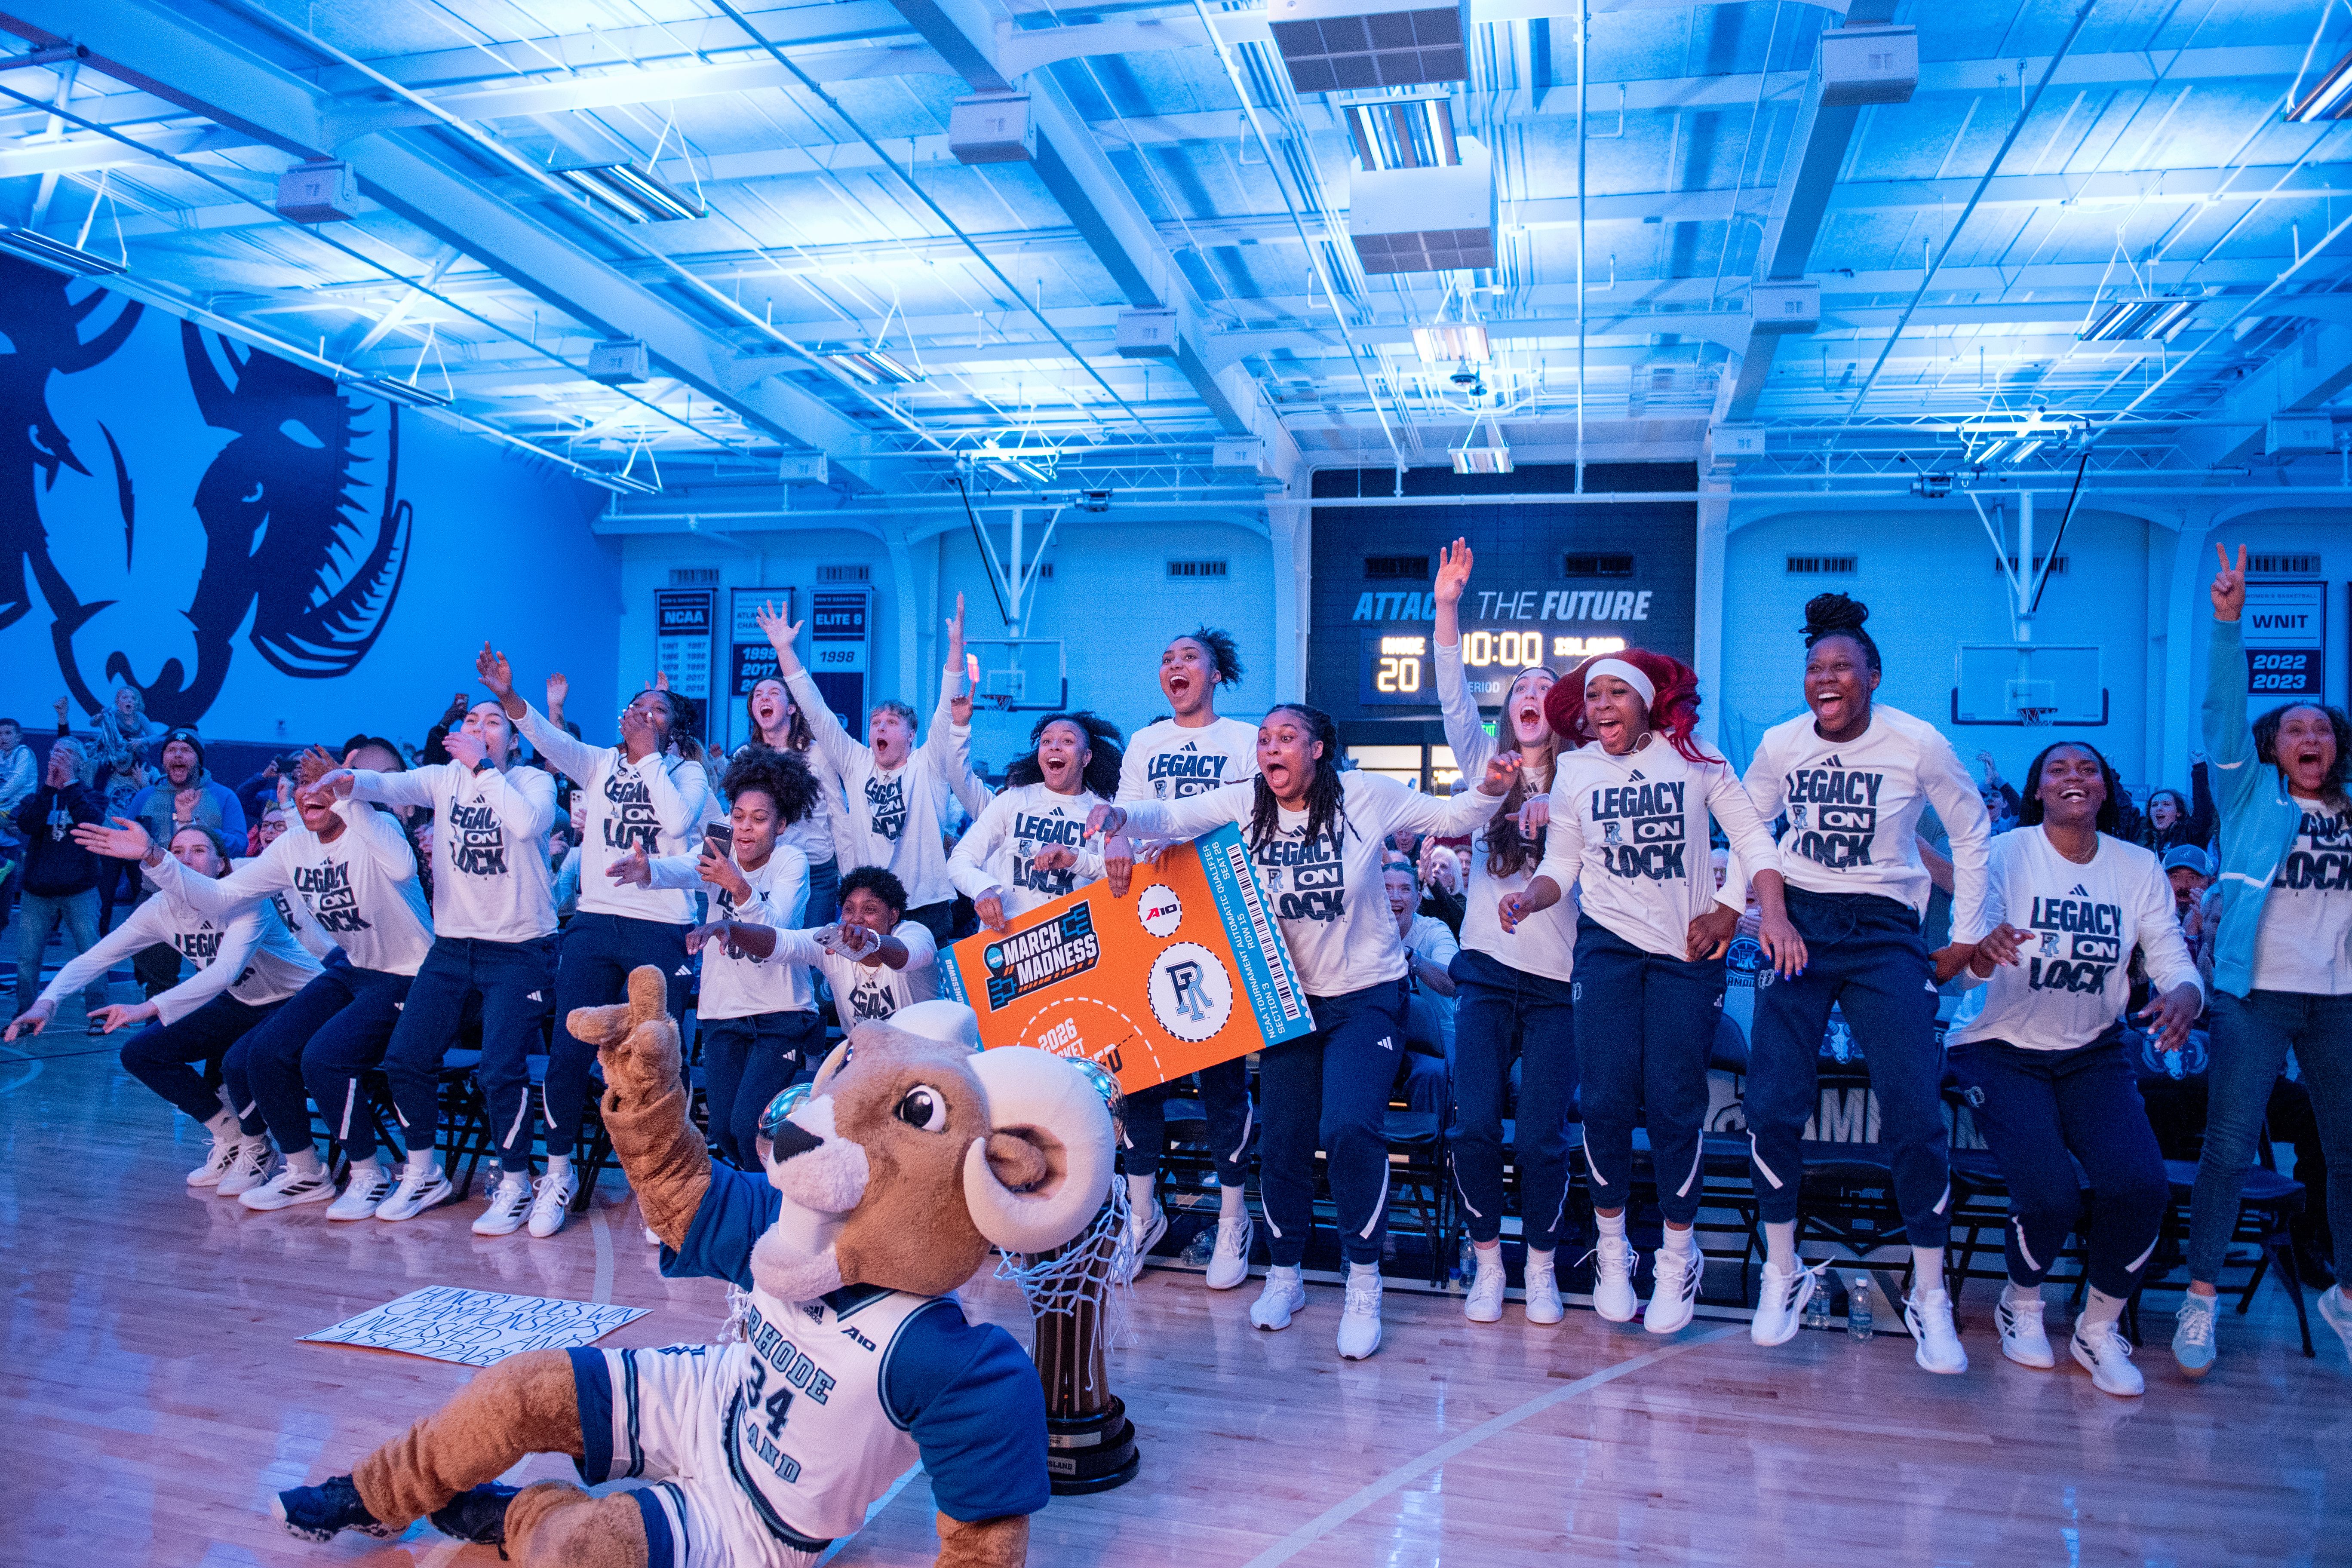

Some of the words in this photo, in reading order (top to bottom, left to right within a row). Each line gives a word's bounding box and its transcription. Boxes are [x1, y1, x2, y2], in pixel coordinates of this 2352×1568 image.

[664, 611, 704, 623] NCAA
[1352, 592, 1435, 621] ATTAC
[1478, 591, 1537, 620] THE
[1540, 590, 1652, 620] FUTURE
[816, 614, 850, 625] ELITE
[854, 614, 862, 625] 8
[2252, 615, 2308, 629] WNIT
[743, 647, 777, 660] 1999
[820, 651, 854, 663] 1998
[1463, 632, 1542, 666] 10:00
[2253, 654, 2306, 669] 2022
[741, 663, 777, 676] 2017
[1379, 658, 1419, 691] 20
[2253, 674, 2306, 688] 2023
[1468, 681, 1500, 693] ERIOD
[1148, 754, 1228, 782] LEGACY
[1179, 782, 1214, 795] ON
[1592, 781, 1685, 821] LEGACY
[1785, 769, 1883, 806] LEGACY
[626, 808, 654, 821] ON
[1824, 811, 1870, 829] ON
[467, 832, 497, 844] ON
[604, 819, 663, 854] LOCK
[1013, 812, 1087, 847] LEGACY
[1638, 821, 1680, 838] ON
[1212, 841, 1222, 855] 26
[1258, 832, 1344, 867] LEGACY
[1600, 843, 1686, 880] LOCK
[294, 861, 349, 892] LEGACY
[1202, 844, 1225, 893] QUALIFIER
[1217, 857, 1230, 880] SEAT
[1298, 868, 1338, 885] ON
[321, 891, 352, 908] ON
[1145, 904, 1178, 921] A10
[315, 907, 372, 932] OCK
[1220, 894, 1244, 948] AUTOMATIC
[1237, 913, 1247, 925] 15
[2030, 896, 2122, 936] LEGACY
[1003, 921, 1062, 966] MARCH
[1242, 927, 1255, 949] ROW
[2077, 940, 2116, 958] ON
[1016, 934, 1097, 986] MADNESS
[1239, 950, 1266, 1013] TOURNAMENT
[2029, 957, 2116, 995] LOCK
[1263, 1013, 1276, 1039] NCAA
[1268, 991, 1285, 1034] SECTION
[1038, 1017, 1078, 1053] 2026
[1056, 1037, 1085, 1059] CKET
[413, 1287, 526, 1308] HUNGRY
[515, 1298, 596, 1317] DOGS
[586, 1305, 646, 1322] WIN
[803, 1307, 823, 1325] adidas
[339, 1314, 502, 1344] UNLEASHED
[384, 1301, 615, 1338] CHAMPIONSHIPS
[304, 1328, 513, 1366] UNSTOPPABL
[840, 1325, 877, 1352] A10
[747, 1305, 836, 1405] RHODE
[748, 1355, 795, 1441] 34
[746, 1423, 801, 1484] AND
